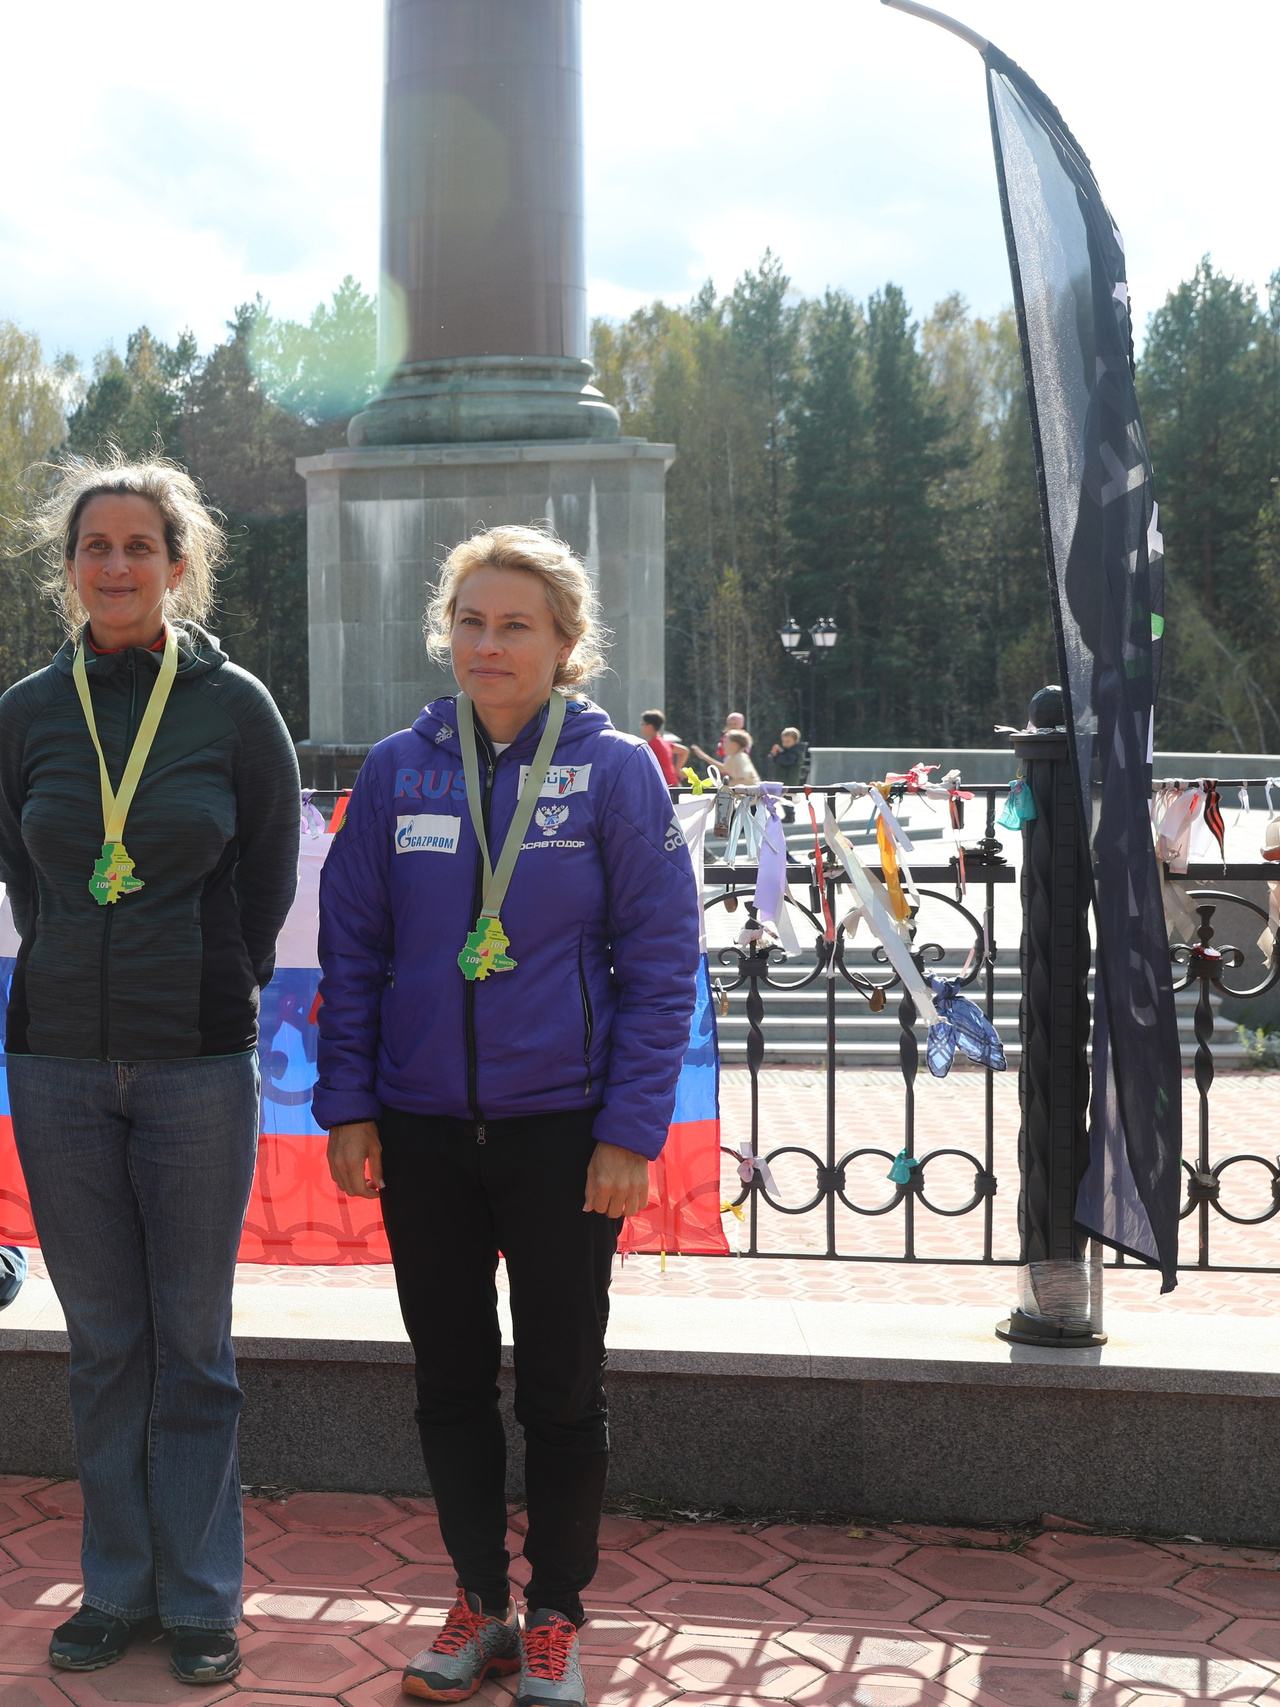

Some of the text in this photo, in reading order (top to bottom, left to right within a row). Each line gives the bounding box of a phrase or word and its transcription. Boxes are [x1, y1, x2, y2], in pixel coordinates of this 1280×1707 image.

[434, 731, 453, 745] adid
[394, 768, 468, 801] RUS
[410, 835, 454, 850] GAZPROM
[520, 840, 586, 851] ОСАВТОДОР
[117, 864, 130, 872] 101
[95, 881, 110, 889] 101
[491, 941, 505, 949] 101
[465, 955, 480, 964] 101
